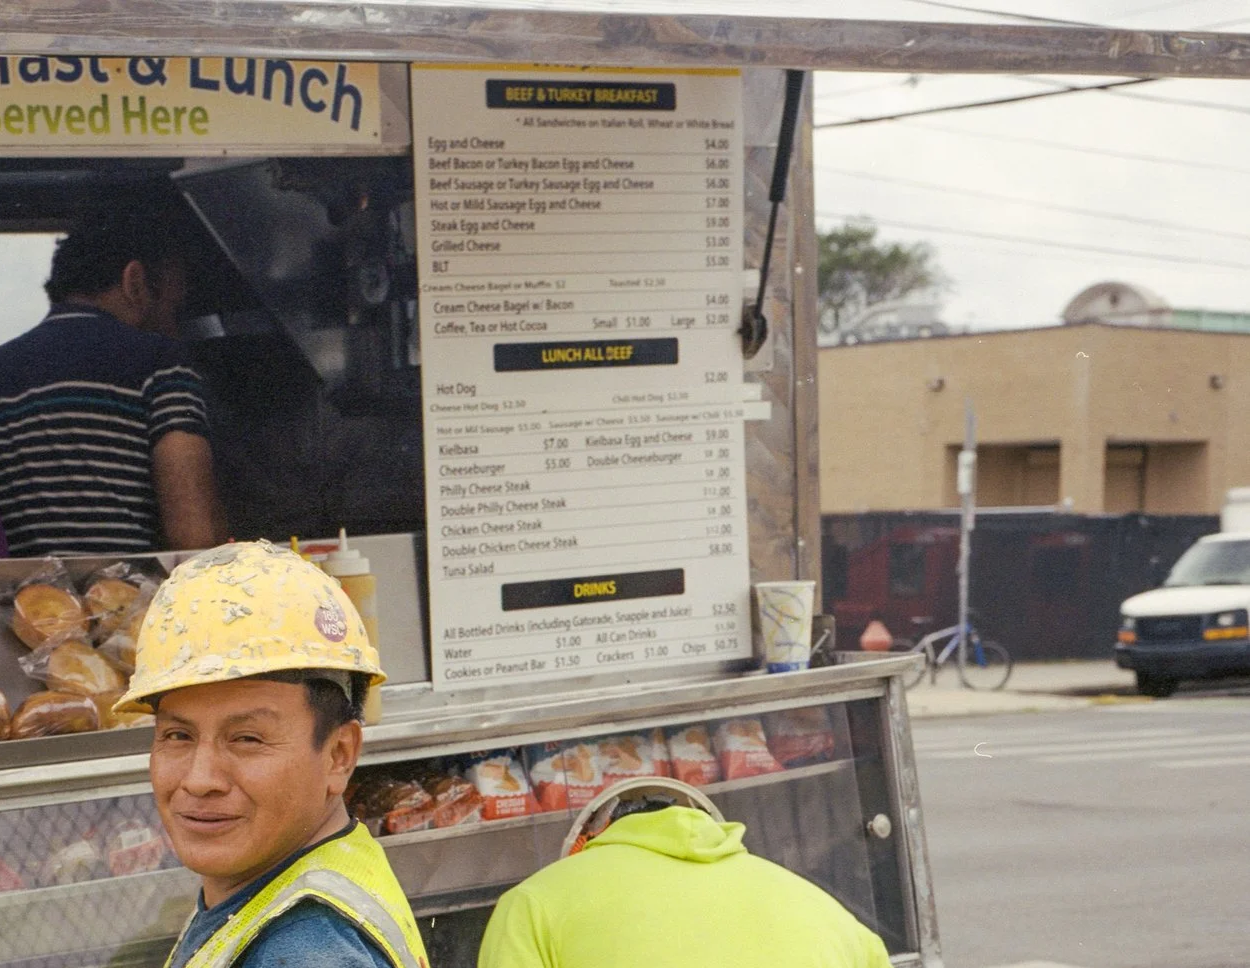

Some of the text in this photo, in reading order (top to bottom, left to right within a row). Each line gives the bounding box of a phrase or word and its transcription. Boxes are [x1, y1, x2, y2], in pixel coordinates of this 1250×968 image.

[190, 57, 362, 131] Lunch
[122, 96, 209, 135] Here
[428, 136, 446, 152] Egg
[450, 137, 468, 148] and
[470, 136, 505, 149] Cheese
[429, 158, 451, 169] Beef
[453, 158, 483, 169] Bacon
[486, 160, 496, 169] or
[498, 158, 528, 172] Turkey
[531, 158, 560, 169] Bacon
[562, 158, 580, 172] Egg
[582, 158, 599, 169] and
[602, 158, 634, 169] Cheese
[430, 178, 452, 190] Beef
[454, 178, 494, 193] Sausage
[496, 180, 506, 190] or
[509, 178, 540, 192] Turkey
[542, 178, 580, 193] Sausage
[583, 178, 600, 193] Egg
[602, 178, 620, 190] and
[622, 178, 654, 190] Cheese
[430, 200, 448, 210] Hot
[450, 202, 460, 210] or
[464, 199, 484, 210] Mild
[487, 199, 526, 213] Sausage
[528, 199, 546, 213] Egg
[549, 199, 566, 210] and
[568, 199, 601, 210] Cheese
[431, 220, 457, 232] Steak
[460, 220, 479, 234] Egg
[481, 220, 499, 230] and
[502, 220, 535, 230] Cheese
[432, 240, 464, 252] Grilled
[467, 240, 501, 251] Cheese
[432, 260, 449, 272] BLT
[434, 302, 465, 314] Cream
[468, 301, 500, 313] Cheese
[503, 300, 530, 314] Bagel
[546, 299, 574, 310] Bacon
[470, 322, 486, 332] Tea
[488, 323, 498, 332] or
[500, 321, 518, 332] Hot
[520, 320, 547, 331] Cocoa
[592, 317, 617, 328] Small
[671, 316, 695, 329] Large
[542, 346, 634, 363] LUNCH ALL BEEF
[437, 384, 454, 395] Hot
[456, 382, 476, 397] Dog
[439, 444, 479, 456] Kielbasa
[624, 434, 642, 447] Egg
[644, 433, 660, 444] and
[662, 431, 693, 442] Cheese
[439, 464, 505, 477] Cheeseburger
[587, 455, 619, 467] Double
[621, 452, 682, 464] Cheeseburger
[441, 481, 530, 498] Philly Cheese Steak
[441, 505, 475, 517] Double
[506, 501, 538, 512] Cheese
[541, 498, 566, 509] Steak
[441, 519, 542, 537] Chicken Cheese Steak
[442, 536, 578, 557] Double Chicken Cheese Steak
[443, 563, 494, 576] Tuna Salad
[574, 580, 616, 598] DRINKS
[444, 628, 456, 640] All
[459, 625, 493, 638] Bottled
[496, 622, 524, 634] Drinks
[616, 611, 649, 624] Snapple
[652, 608, 667, 618] and
[444, 649, 472, 659] Water
[596, 633, 607, 644] All
[610, 632, 626, 642] Can
[629, 628, 657, 640] Drinks
[445, 666, 481, 680] Cookies
[484, 666, 493, 675] or
[496, 661, 528, 674] Peanut
[531, 660, 546, 670] Bar
[596, 651, 634, 663] Crackers
[682, 643, 706, 655] Chips
